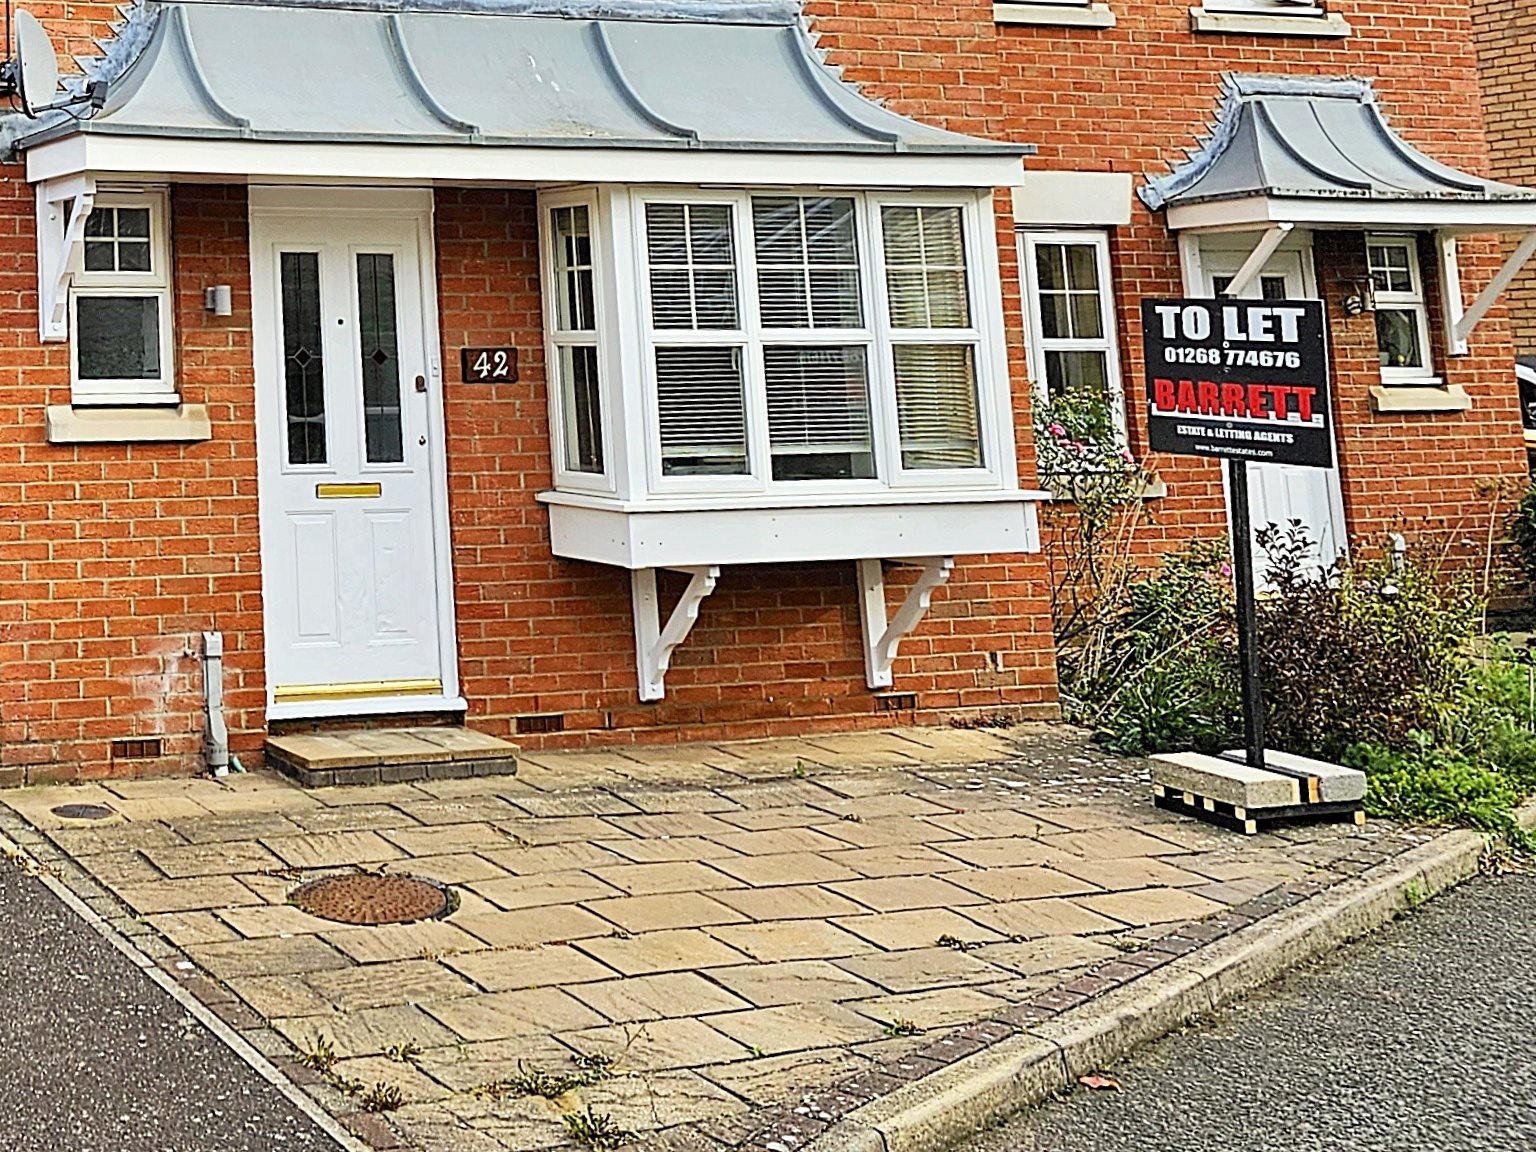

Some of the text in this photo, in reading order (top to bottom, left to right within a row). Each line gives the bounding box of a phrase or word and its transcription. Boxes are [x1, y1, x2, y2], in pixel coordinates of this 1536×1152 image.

[1155, 306, 1305, 342] TO LET
[473, 351, 508, 378] 42
[1164, 346, 1300, 368] 01268 774676
[1154, 379, 1316, 420] BARRETT
[1177, 425, 1294, 443] ESTATE & LETTING AGENTS
